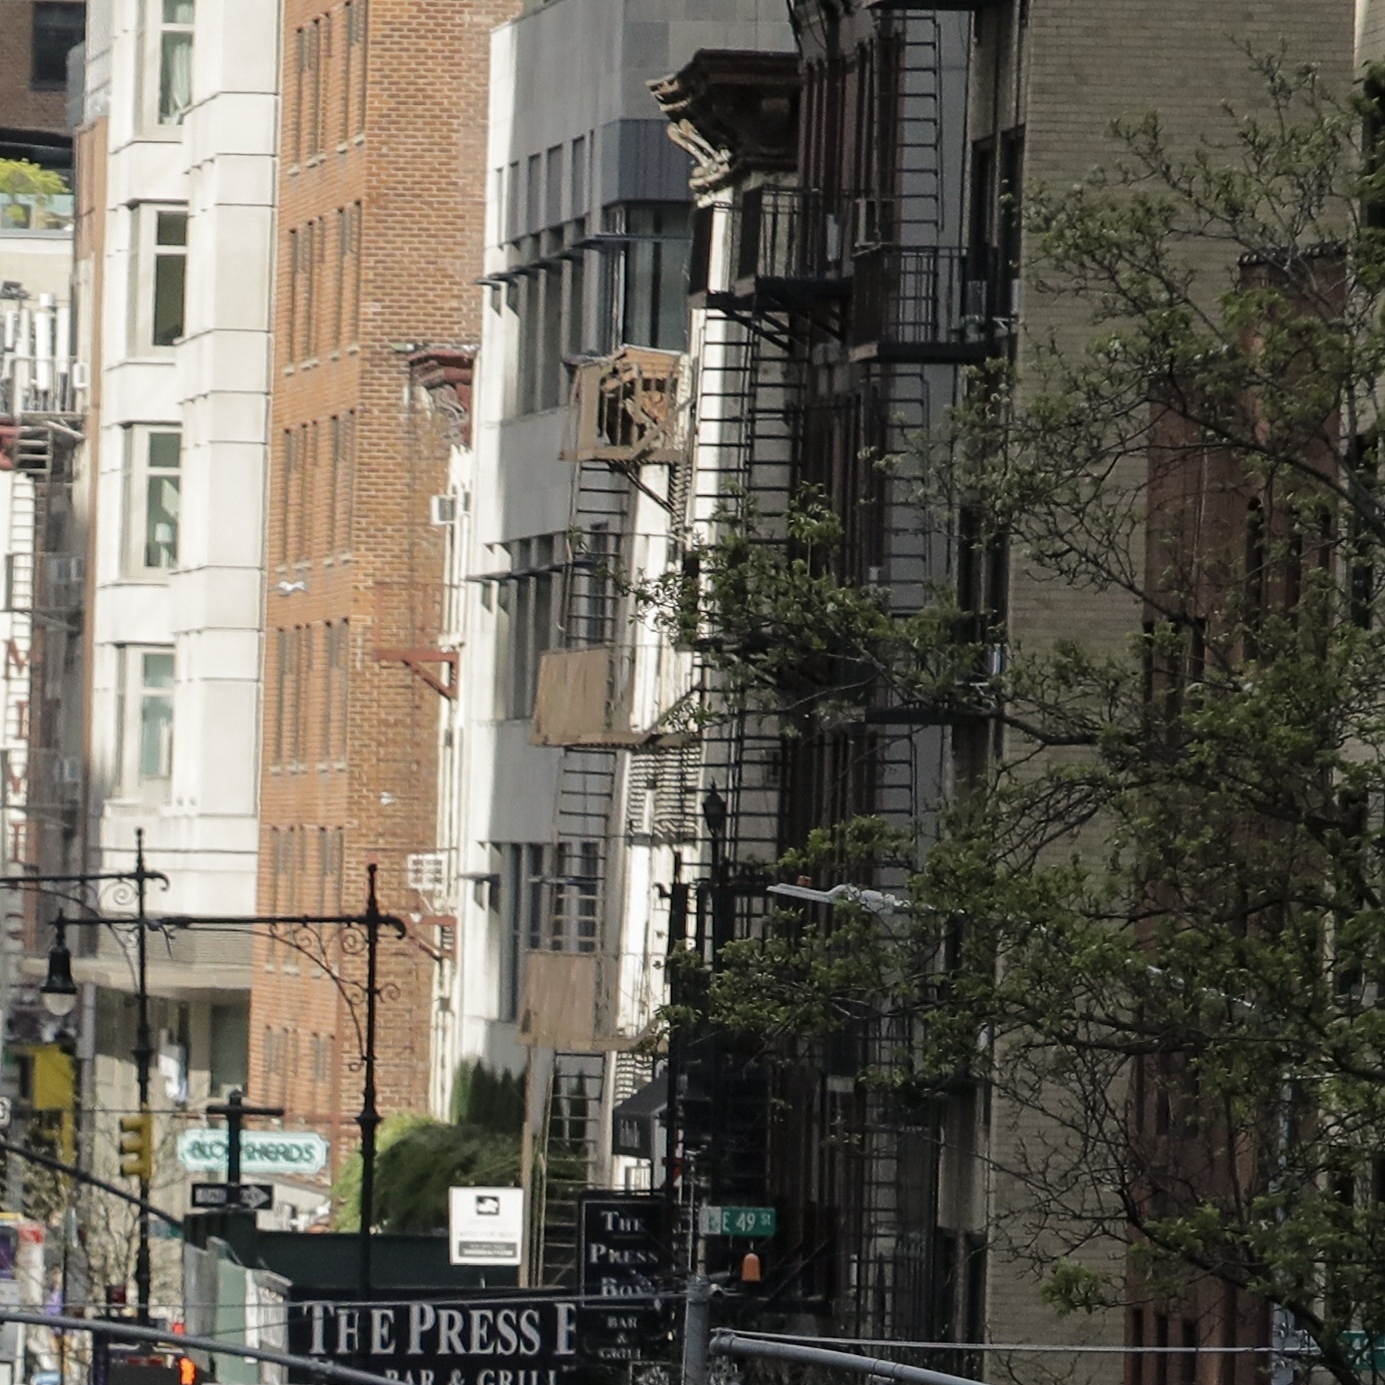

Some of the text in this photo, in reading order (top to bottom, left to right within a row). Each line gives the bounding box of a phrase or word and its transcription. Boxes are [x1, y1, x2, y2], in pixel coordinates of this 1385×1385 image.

[722, 1211, 731, 1232] E
[735, 1211, 756, 1232] 49
[302, 1300, 395, 1355] THE
[407, 1302, 542, 1356] PRESS
